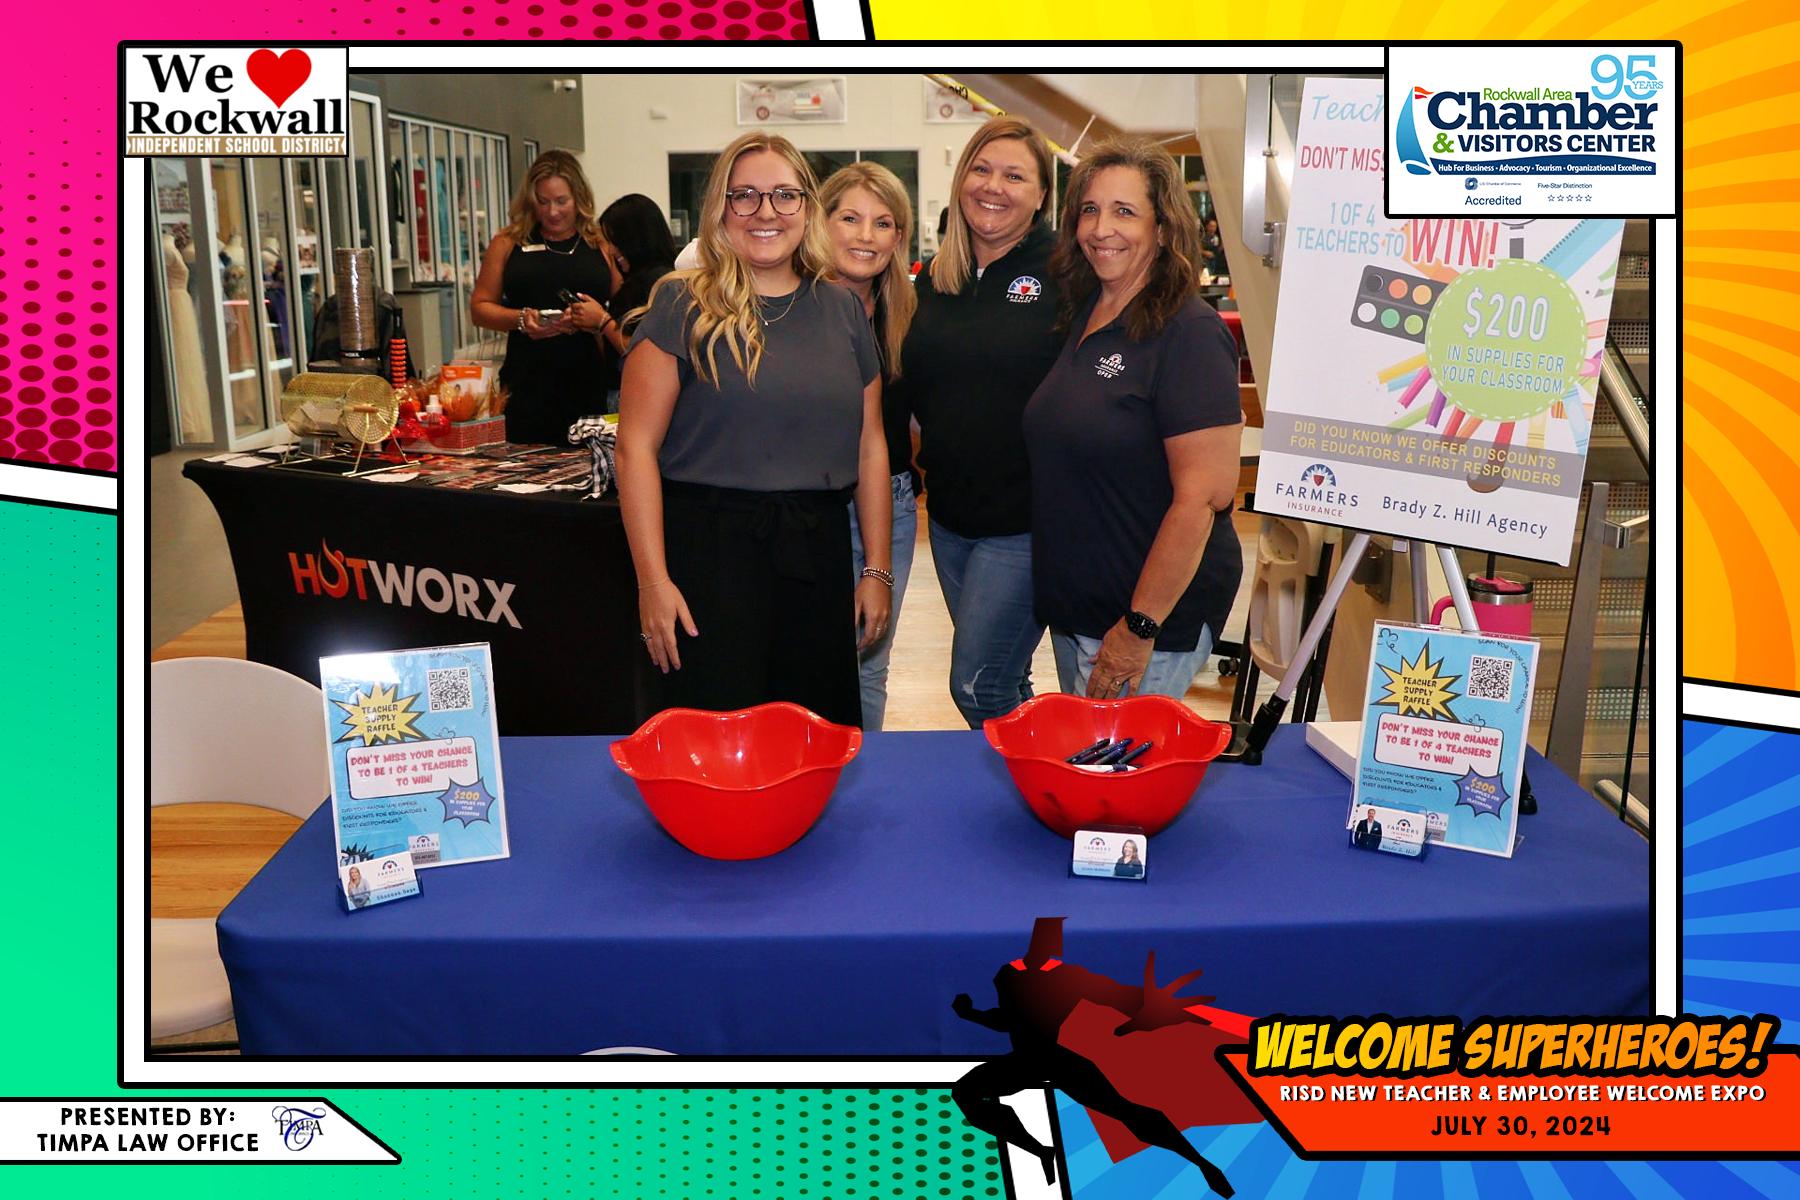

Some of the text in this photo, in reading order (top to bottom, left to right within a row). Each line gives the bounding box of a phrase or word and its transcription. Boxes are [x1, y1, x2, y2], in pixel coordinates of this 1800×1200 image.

[1300, 145, 1384, 172] DON'T MIS
[1330, 202, 1376, 227] 1 OF 4
[1296, 226, 1405, 257] TEACHERS TO
[1412, 218, 1500, 269] WIN!
[1462, 286, 1550, 341] $200
[1447, 345, 1566, 373] IN SUPPLIES FOR
[1442, 365, 1563, 394] YOUR CLASSROOM
[1294, 420, 1557, 470] DID YOU KNOW WE OFFER DISCOUNTS
[1290, 435, 1562, 487] FOR EDUCATORS & FIRST RESPONDERS
[1275, 482, 1359, 507] FARMERS
[1287, 501, 1343, 518] INSURANCE
[1382, 496, 1548, 539] Brady Z. Hill Agency
[287, 538, 524, 630] HOTWORX
[1402, 676, 1437, 688] TEACHER
[1403, 686, 1433, 697] SUPPLY
[361, 703, 398, 714] TEACHER
[1402, 695, 1431, 706] RAFFLE
[365, 714, 397, 724] SUPPLY
[366, 723, 396, 733] RAFFLE
[1381, 721, 1499, 747] DON'T MISS YOUR CHANCE
[350, 745, 473, 766] DON'T MISS YOUR CHANCE
[1385, 735, 1398, 744] TO
[1400, 737, 1412, 747] BE
[1413, 739, 1418, 747] 1
[1421, 740, 1433, 749] OF
[1445, 743, 1492, 759] TEACHERS
[1418, 752, 1455, 766] TO WIN!
[357, 759, 468, 777] TO BE 1 OF 4 TEACHERS
[395, 774, 433, 786] TO WIN!
[454, 789, 480, 800] $200
[1471, 777, 1496, 794] $200
